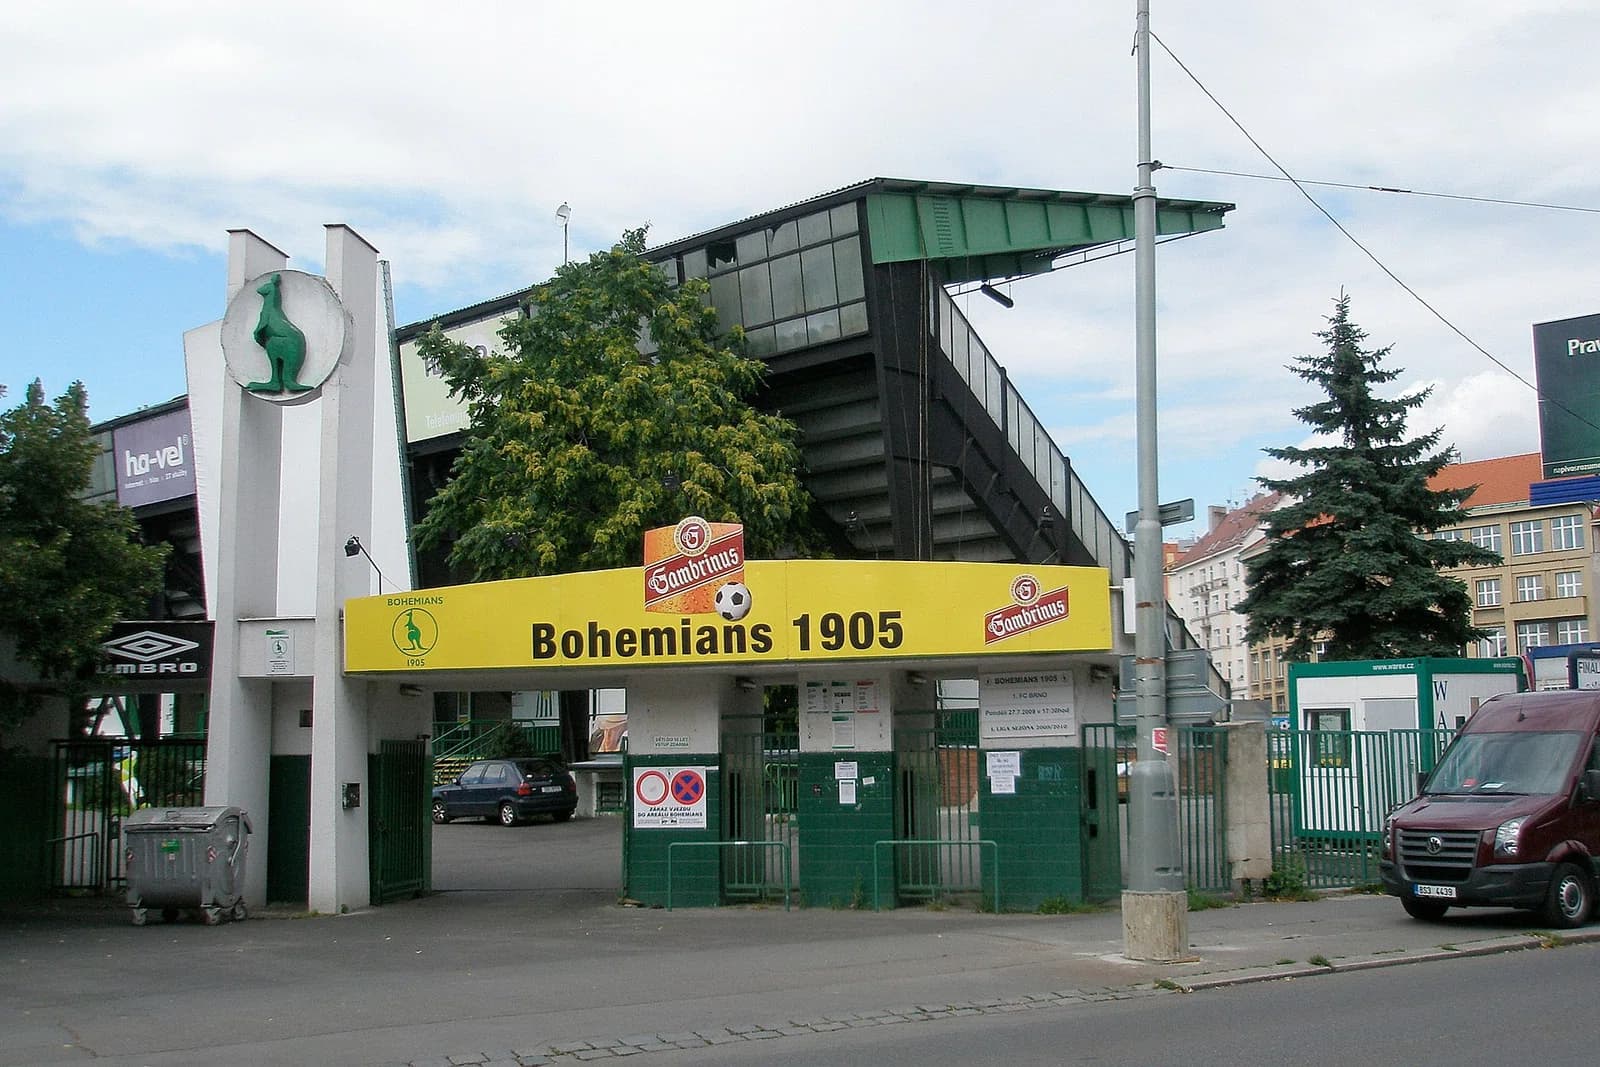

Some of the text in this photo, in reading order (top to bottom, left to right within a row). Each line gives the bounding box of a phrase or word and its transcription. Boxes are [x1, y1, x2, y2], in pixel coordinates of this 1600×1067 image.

[125, 436, 184, 477] ha-vel
[648, 547, 739, 594] Gambrinus
[387, 596, 444, 606] BOHEMIANS
[988, 599, 1065, 637] Gambrinus
[531, 610, 904, 660] Bohemians 1905
[407, 658, 425, 667] 1905
